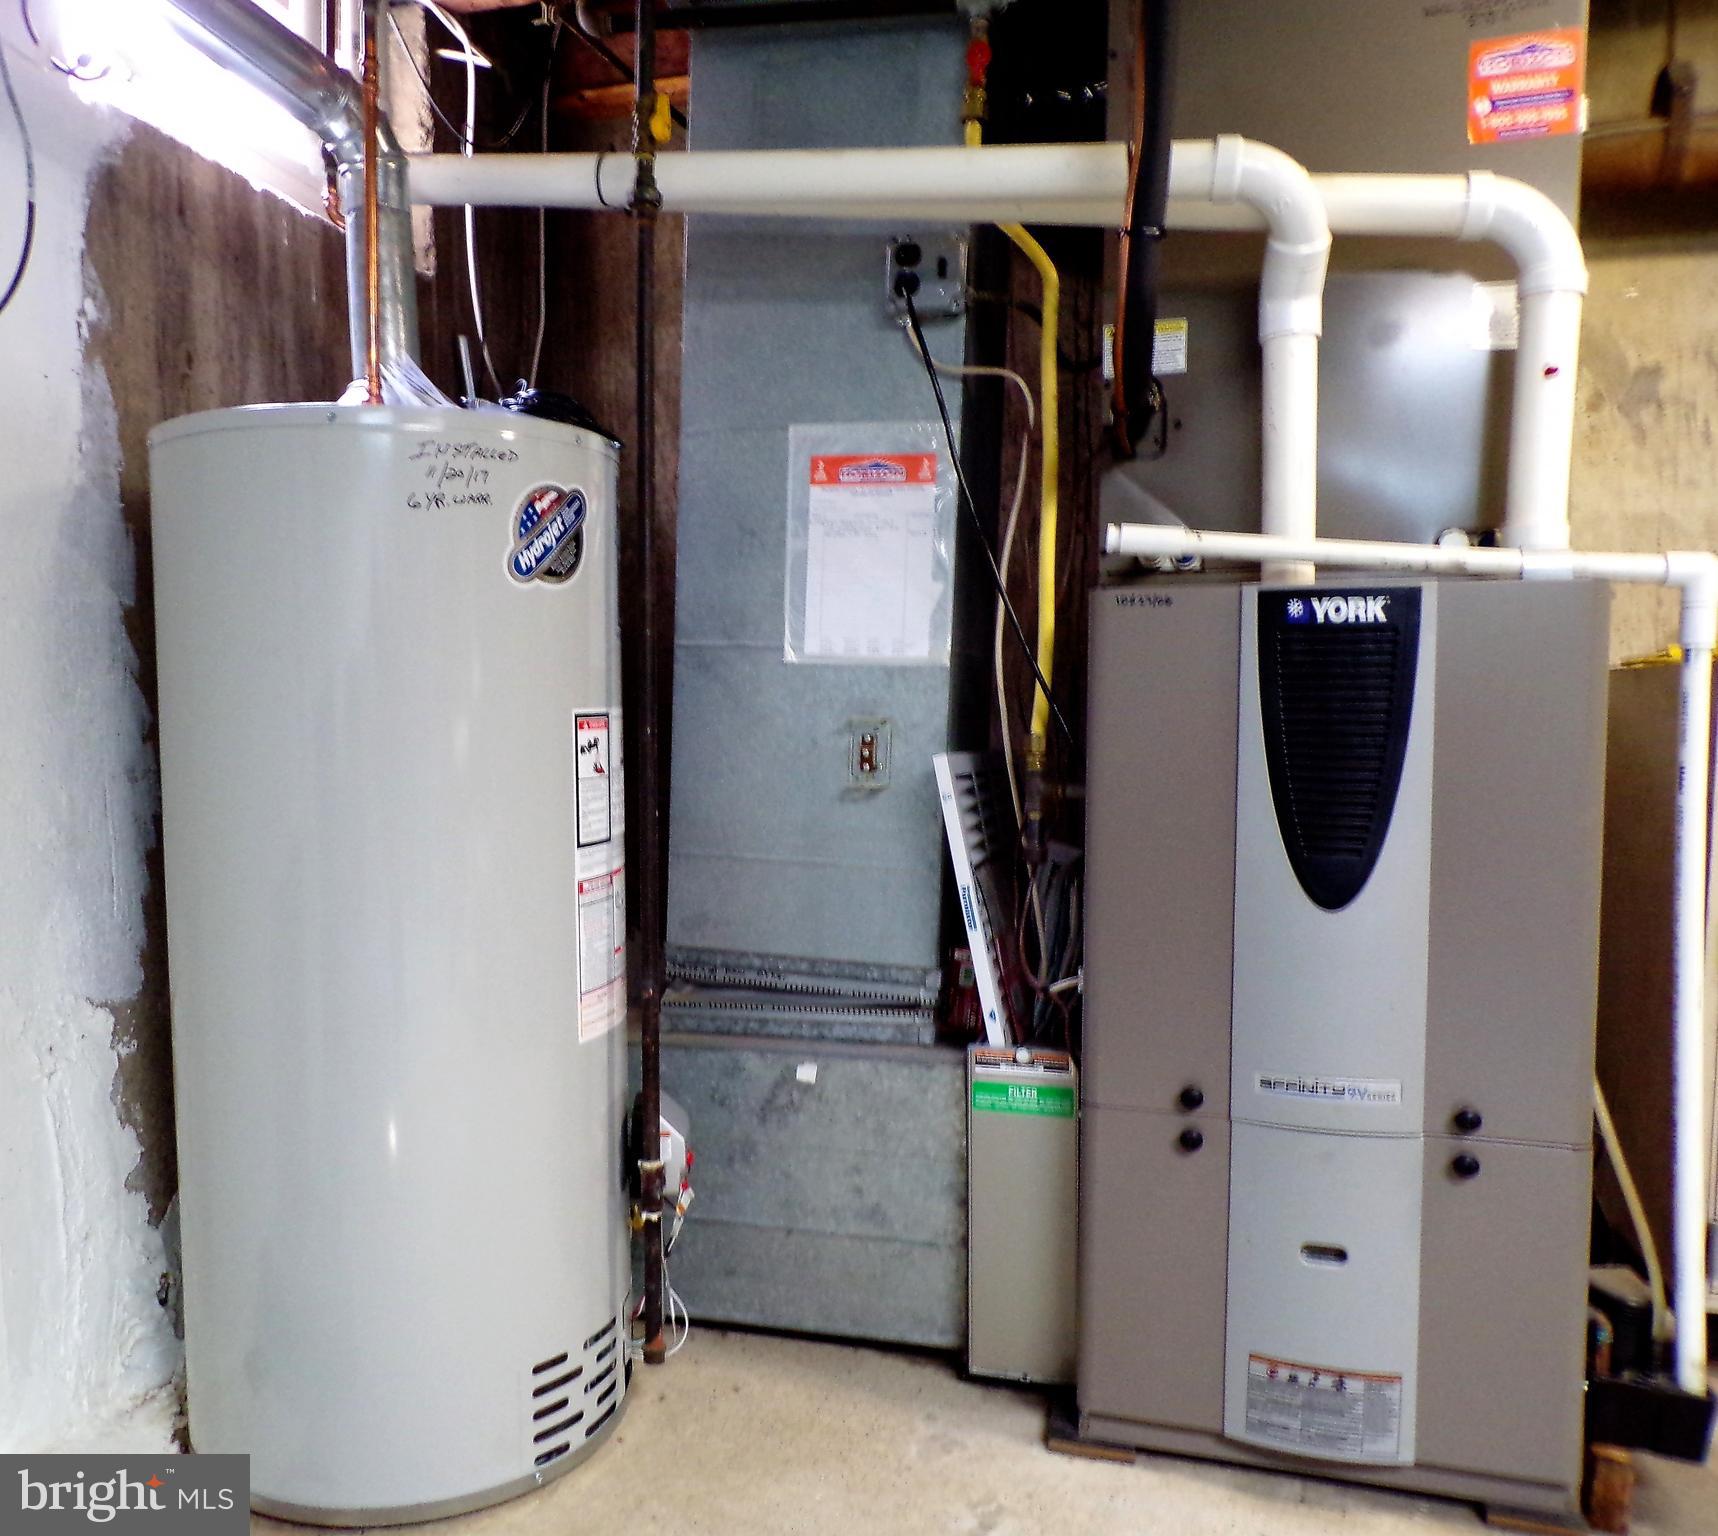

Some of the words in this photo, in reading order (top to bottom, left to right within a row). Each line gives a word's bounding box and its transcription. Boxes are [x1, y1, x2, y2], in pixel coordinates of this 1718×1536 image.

[407, 492, 421, 508] 6
[1311, 596, 1387, 624] YORK
[1008, 1085, 1038, 1099] FILTER
